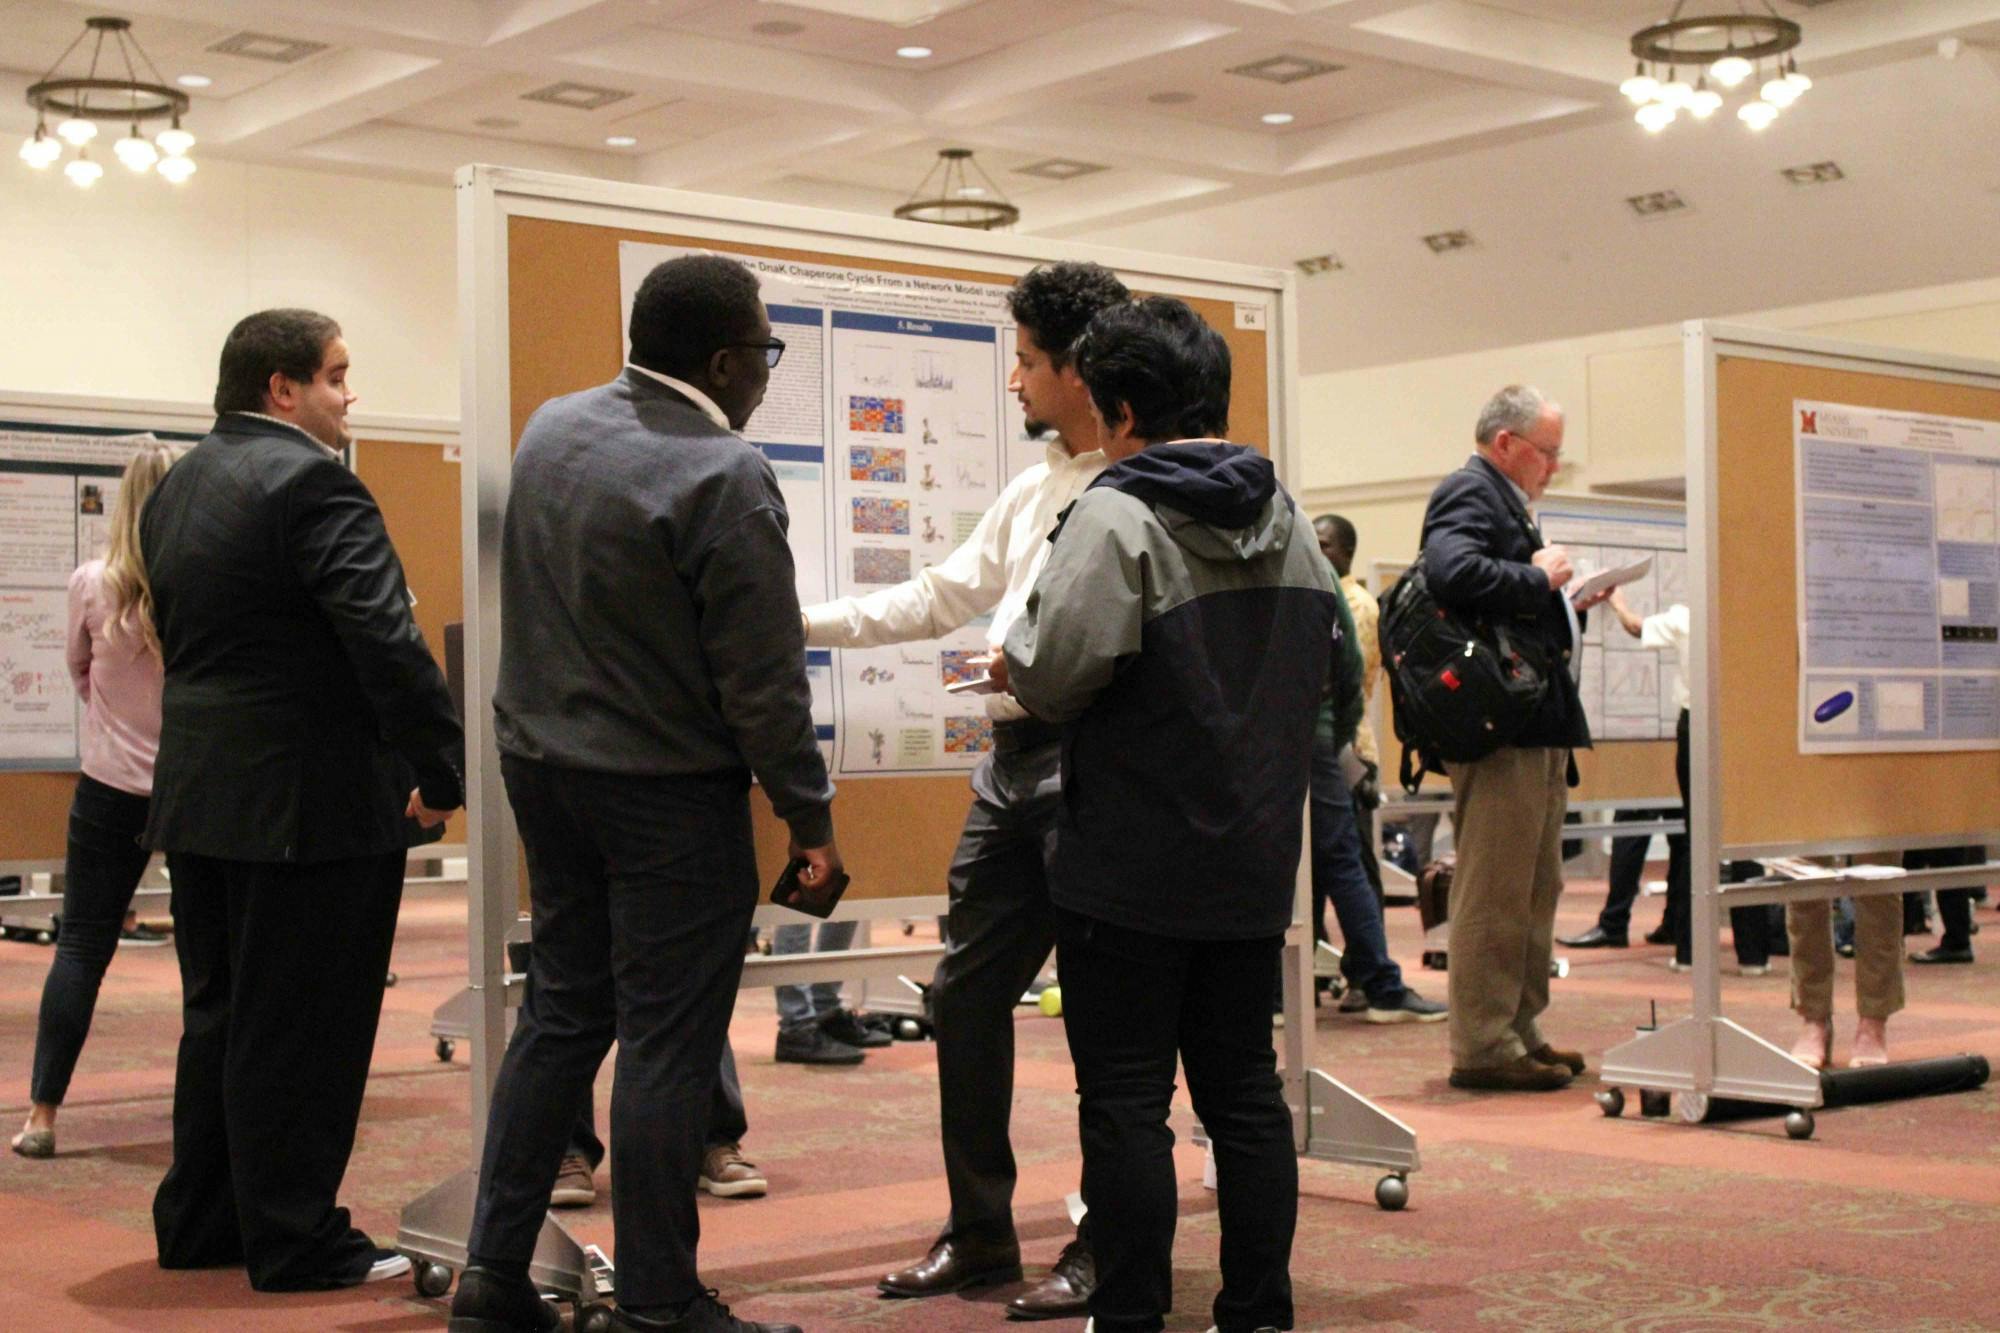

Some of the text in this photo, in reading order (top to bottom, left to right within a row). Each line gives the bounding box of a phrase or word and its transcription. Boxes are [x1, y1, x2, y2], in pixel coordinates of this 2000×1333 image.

[758, 261, 788, 275] DnaK
[789, 265, 845, 280] Chaperone
[846, 271, 874, 285] Cycle
[876, 275, 903, 287] From
[905, 280, 912, 288] a
[913, 279, 953, 292] Network
[954, 284, 984, 296] Model
[985, 287, 1008, 298] usin
[906, 320, 933, 333] Results
